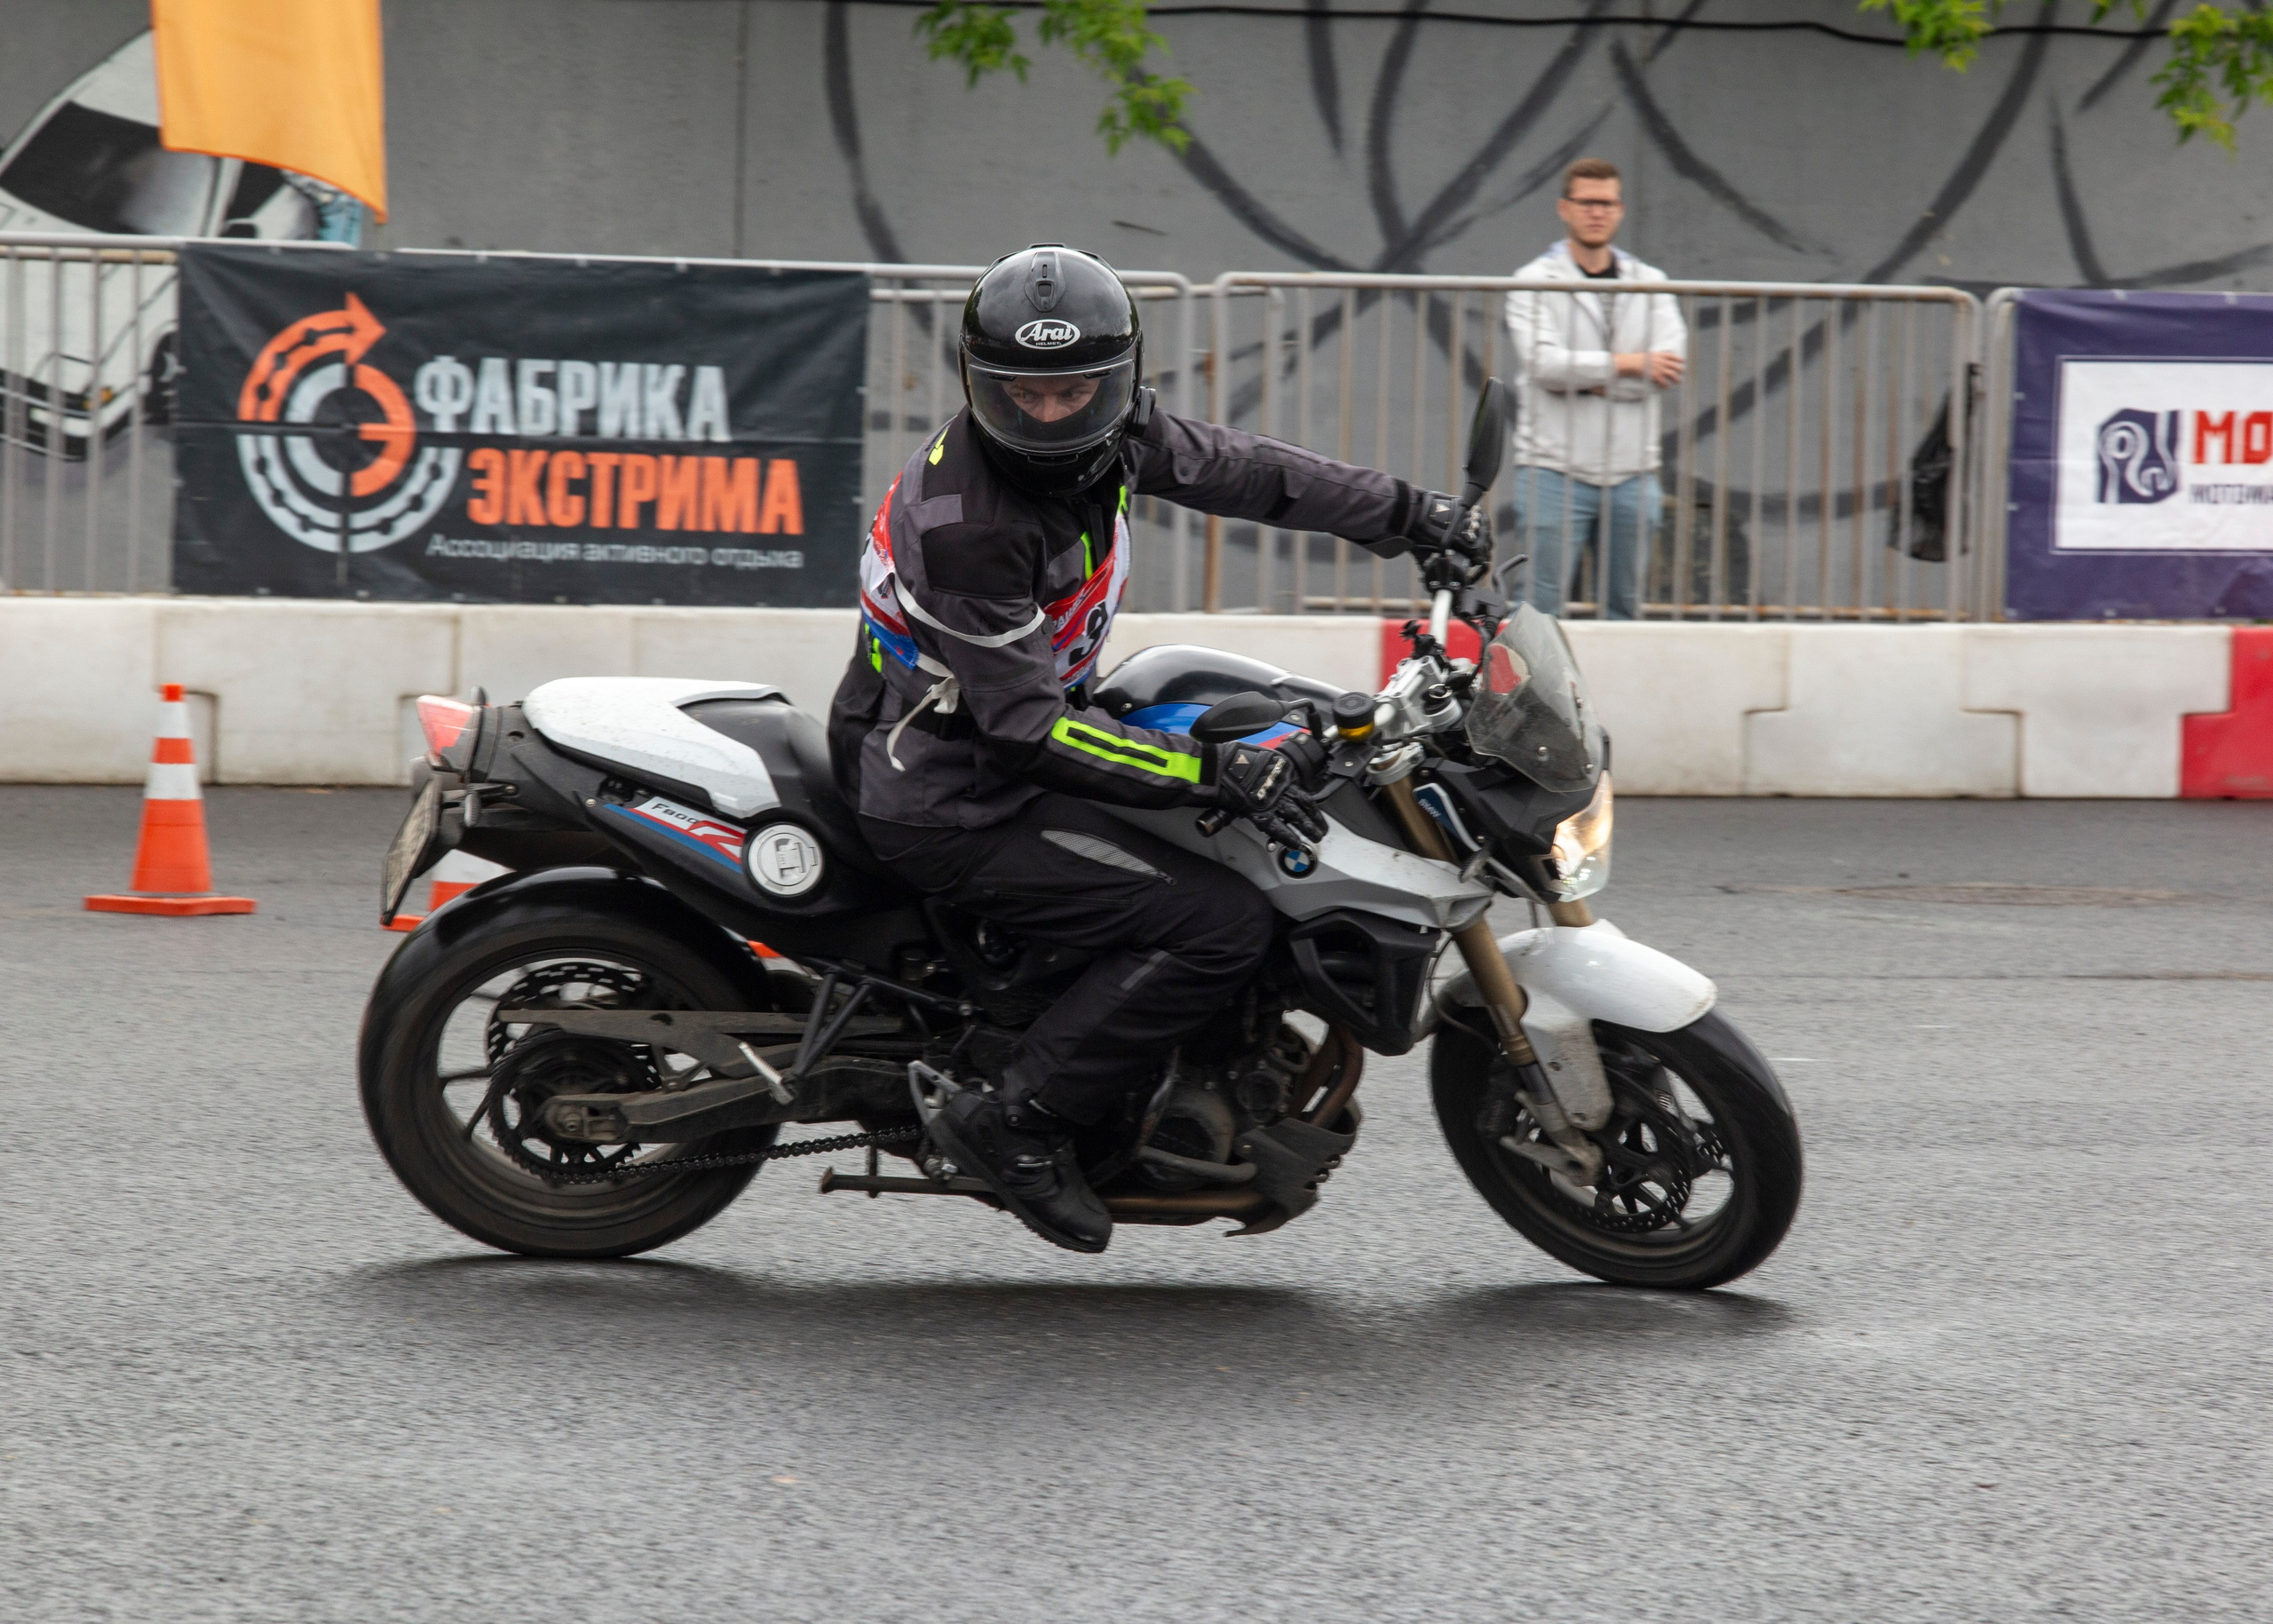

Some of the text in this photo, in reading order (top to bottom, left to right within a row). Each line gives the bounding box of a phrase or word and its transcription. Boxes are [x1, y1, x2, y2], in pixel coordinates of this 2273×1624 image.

[1020, 322, 1073, 342] Arai
[416, 355, 731, 442] ФАБРИКА
[467, 448, 804, 535] ЭКСТРИМА
[424, 533, 804, 570] Ассоциация активного отдыха
[1417, 798, 1442, 818] BMW
